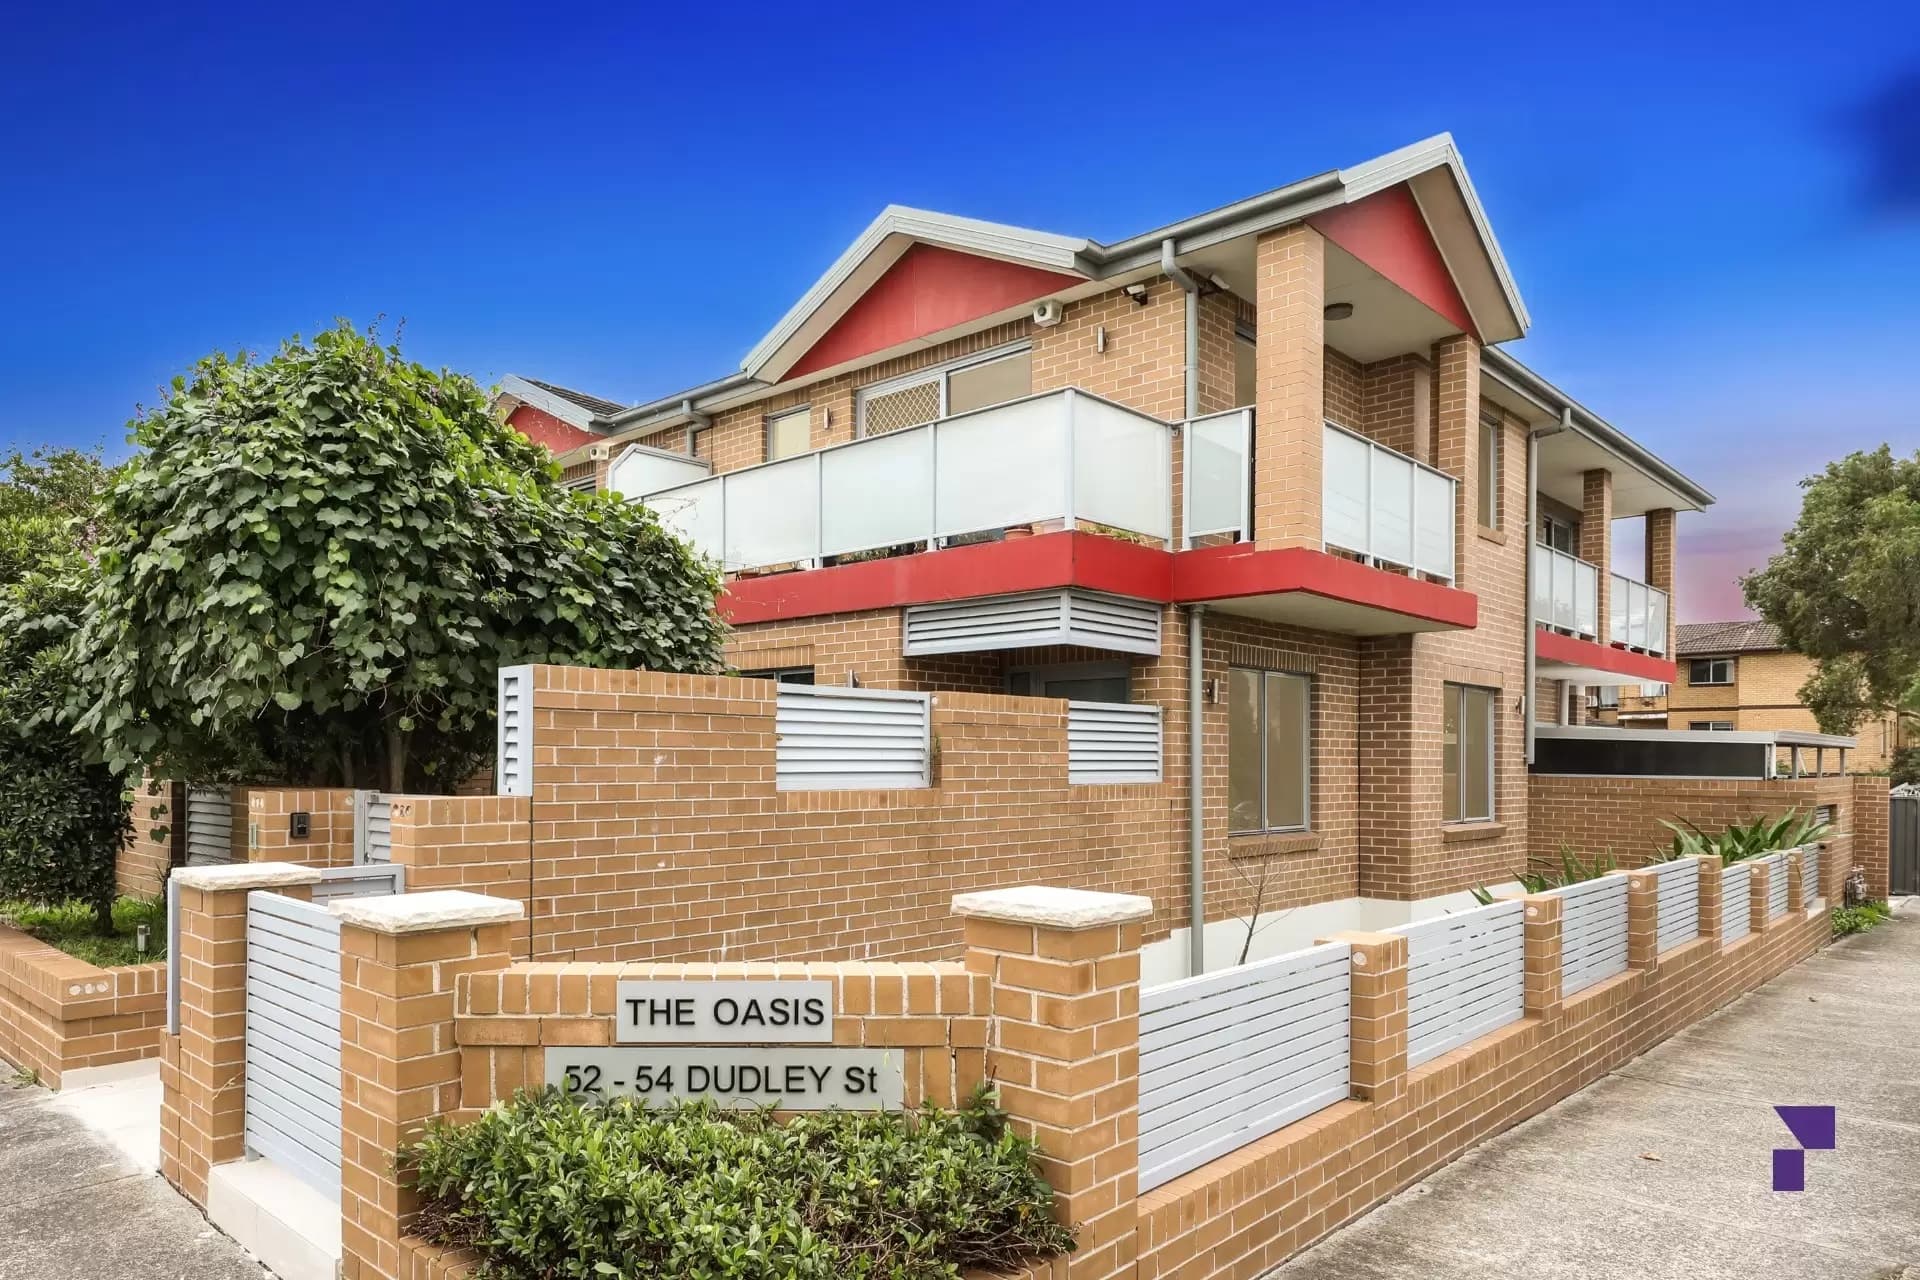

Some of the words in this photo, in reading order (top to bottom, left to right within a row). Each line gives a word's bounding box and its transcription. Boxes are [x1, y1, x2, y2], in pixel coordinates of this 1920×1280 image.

[625, 998, 696, 1026] THE
[713, 997, 825, 1027] OASIS
[564, 1065, 602, 1093] 52
[635, 1065, 675, 1094] 54
[687, 1065, 832, 1094] DUDLEY
[843, 1066, 878, 1095] St
